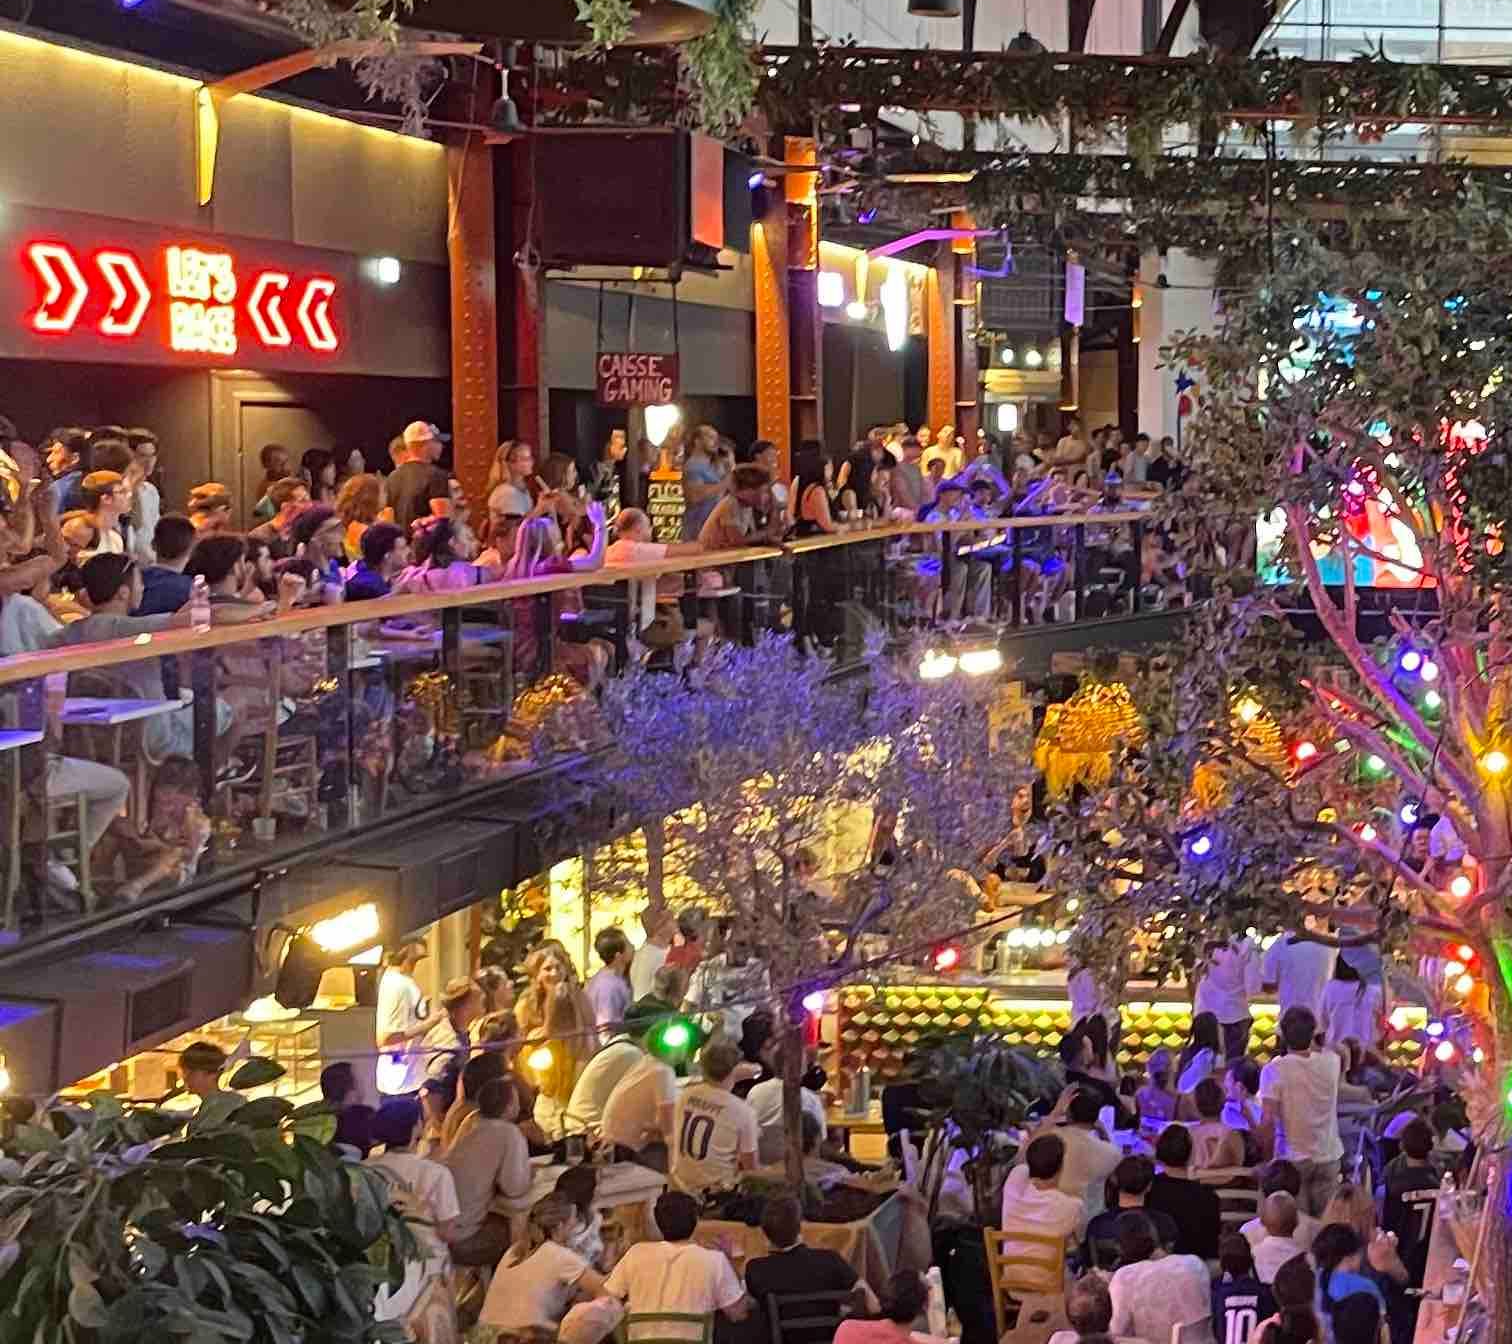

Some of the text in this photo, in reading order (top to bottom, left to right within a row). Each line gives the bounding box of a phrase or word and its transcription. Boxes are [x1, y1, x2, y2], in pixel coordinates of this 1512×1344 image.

[600, 355, 663, 377] CAISSE
[604, 377, 672, 402] GAMING
[680, 1112, 714, 1160] 10
